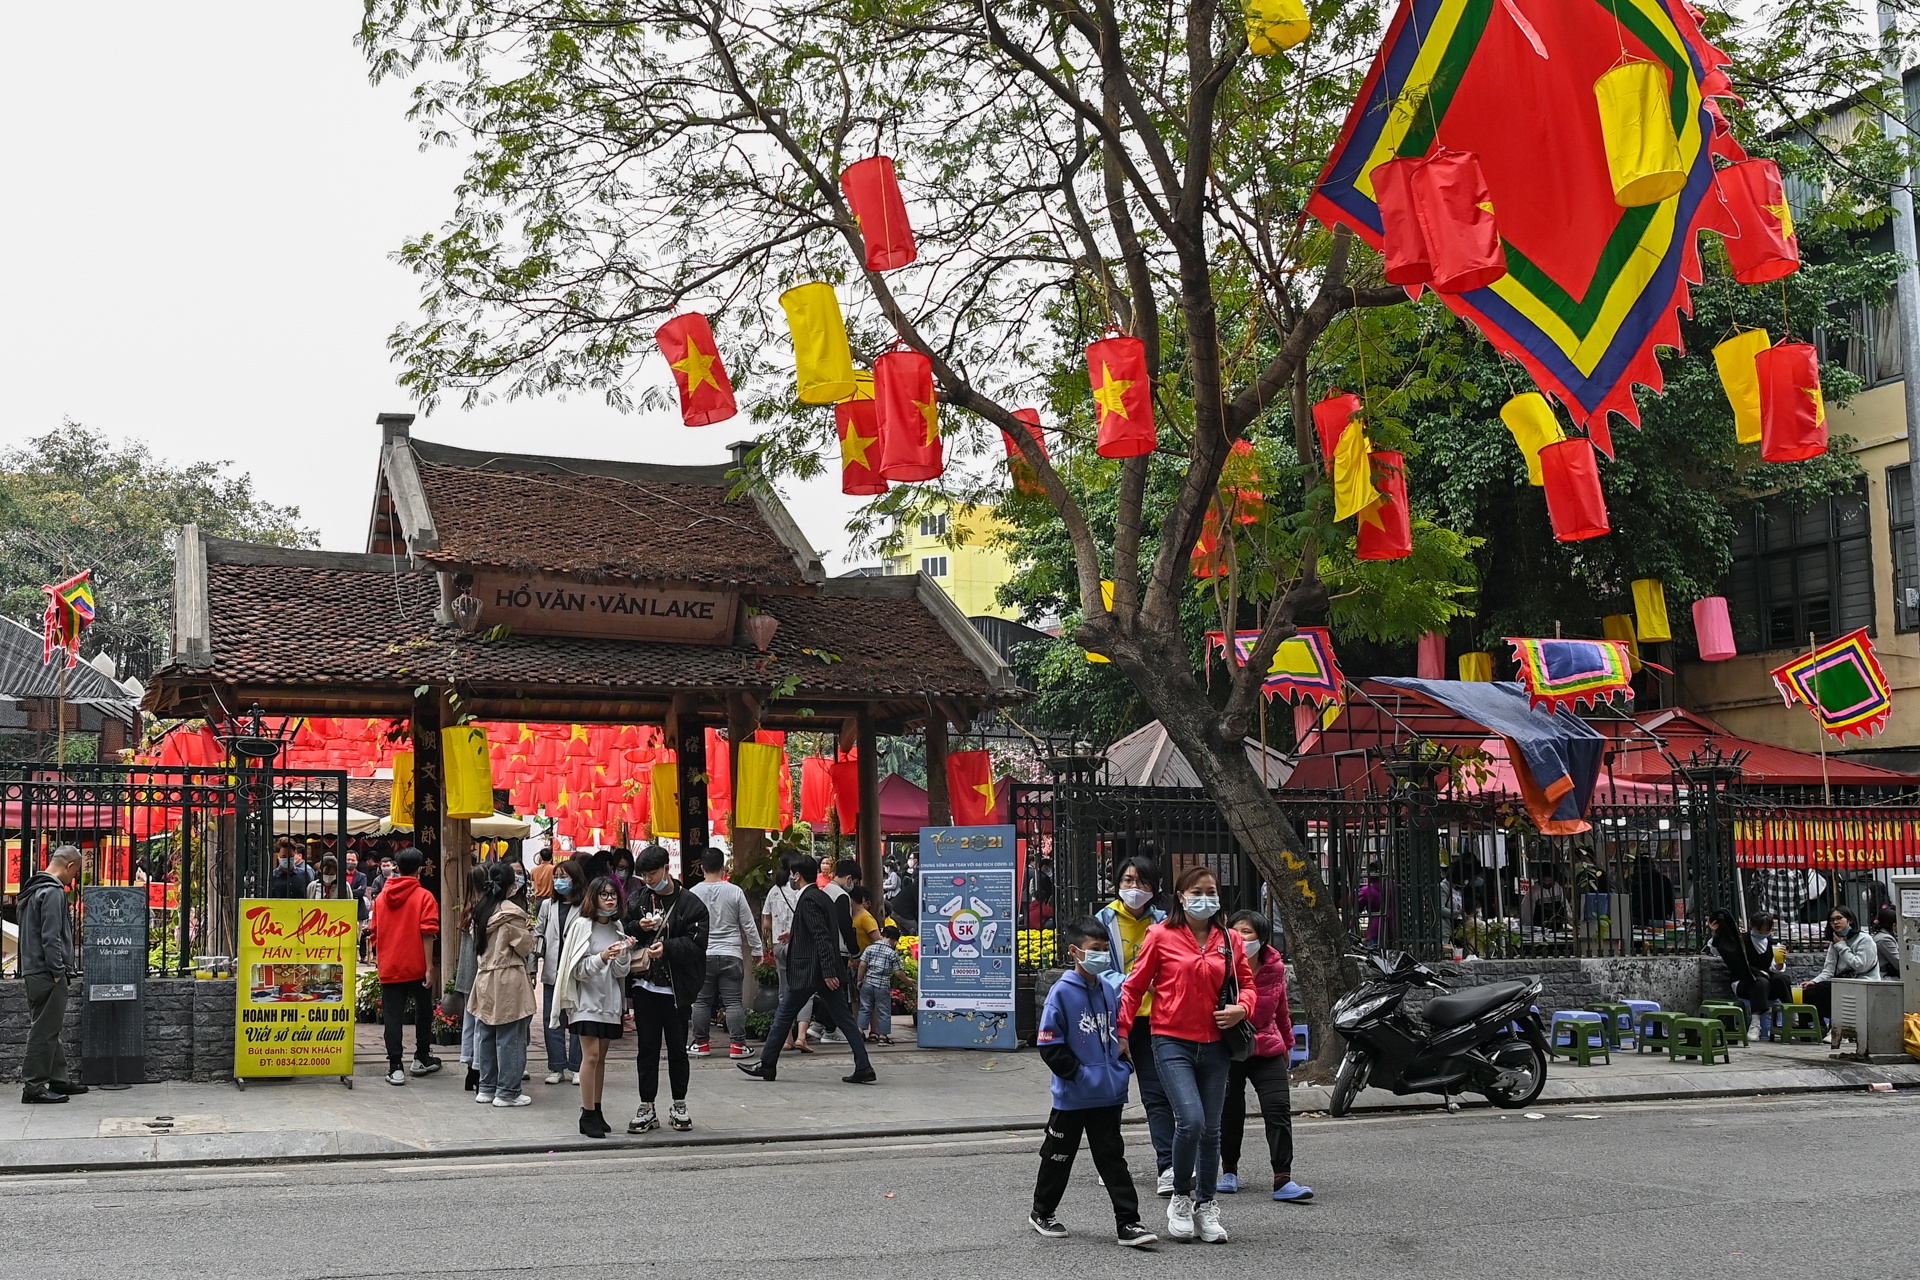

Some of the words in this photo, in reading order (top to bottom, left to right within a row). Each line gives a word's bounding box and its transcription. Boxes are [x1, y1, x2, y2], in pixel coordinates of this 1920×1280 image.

[495, 583, 532, 607] HỒ
[535, 588, 586, 611] VĂN
[597, 593, 647, 615] VĂN
[650, 599, 716, 620] LAKE
[958, 925, 974, 935] 5K
[113, 937, 132, 945] VĂN
[262, 946, 293, 959] HÁN
[305, 946, 334, 960] VIỆT
[242, 1007, 278, 1022] HOÀNH
[281, 1009, 298, 1022] PHI
[308, 1007, 328, 1022] CÂU
[332, 1004, 349, 1022] ĐỐI
[245, 1025, 272, 1042] Viết
[274, 1027, 290, 1042] sớ
[291, 1025, 313, 1042] cầu
[316, 1027, 346, 1041] danh
[248, 1047, 262, 1055] Bút
[264, 1047, 288, 1055] danh:
[290, 1046, 309, 1054] SƠN
[311, 1045, 342, 1054] KHÁCH
[276, 1058, 331, 1066] 0834.22.0000
